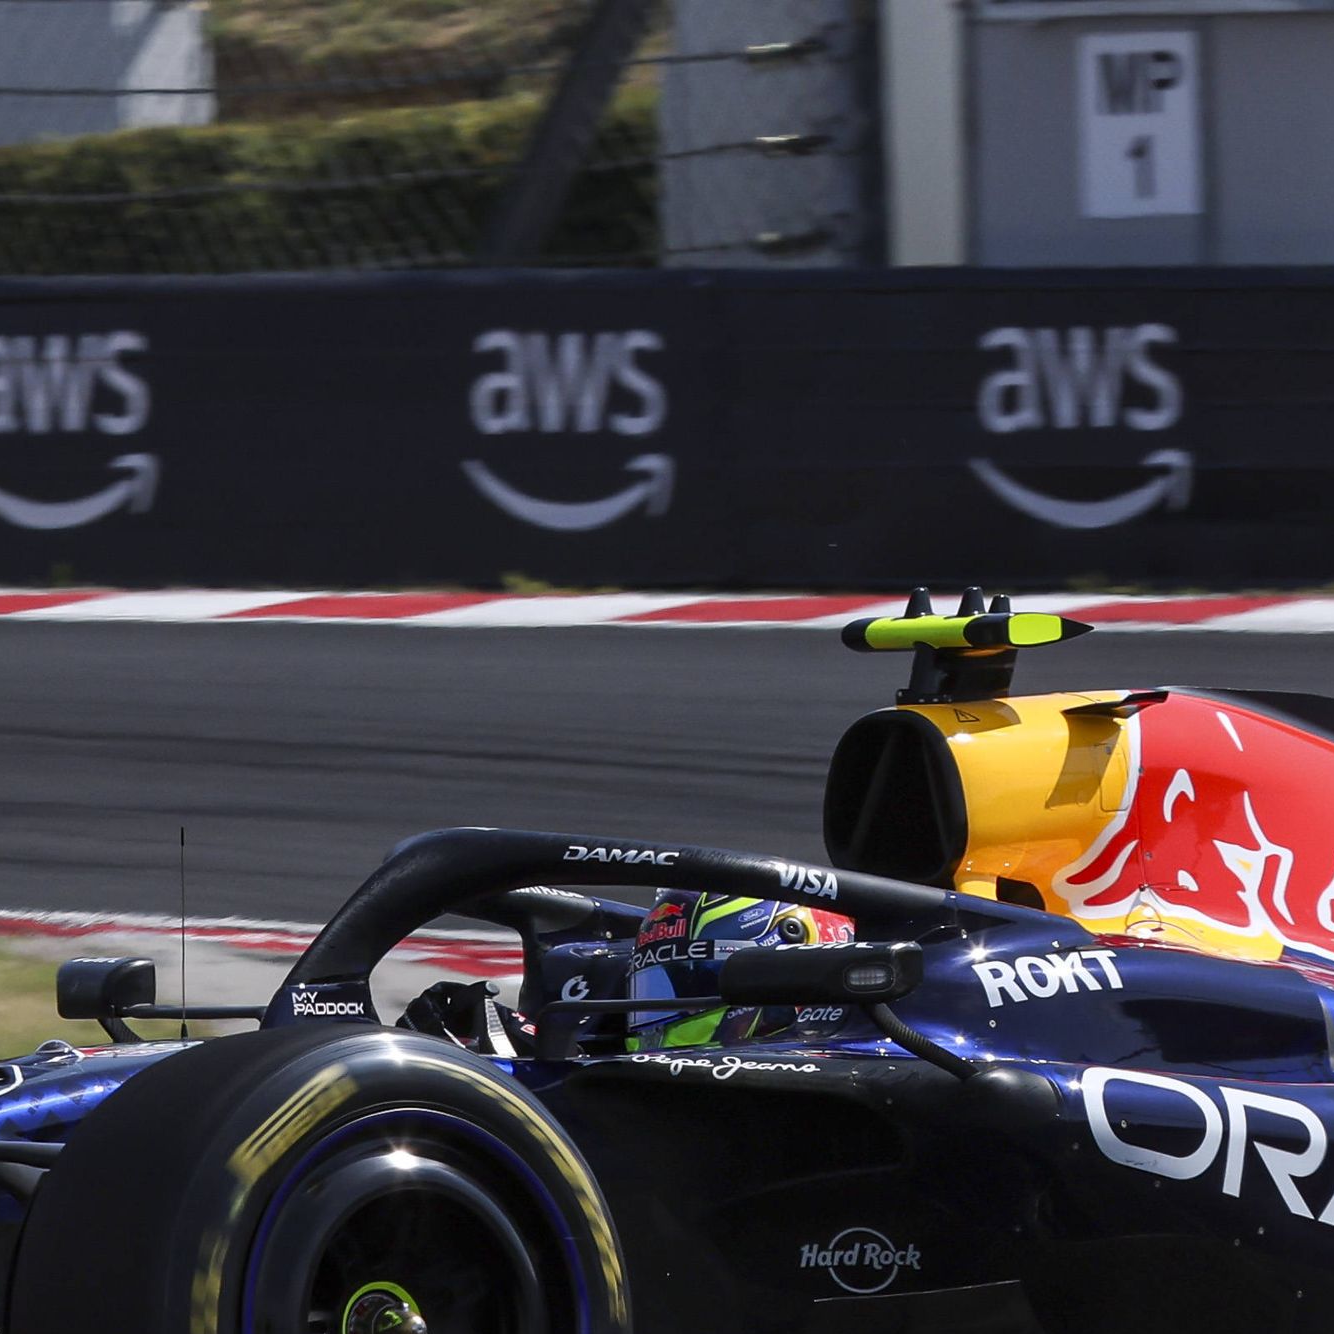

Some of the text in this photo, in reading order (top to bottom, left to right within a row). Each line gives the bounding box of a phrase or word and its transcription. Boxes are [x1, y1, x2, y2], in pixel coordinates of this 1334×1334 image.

[1125, 134, 1157, 199] 1
[469, 330, 666, 435] aws
[977, 323, 1184, 433] aws
[563, 845, 679, 866] DAMAC
[771, 862, 838, 900] VISA
[656, 918, 686, 940] Bull
[759, 934, 781, 947] VISA
[972, 944, 1125, 1008] ROKT
[291, 991, 318, 1003] MY
[293, 1001, 364, 1016] PADDOCK
[712, 1056, 820, 1079] Jeans
[800, 1241, 922, 1271] Hard Rock
